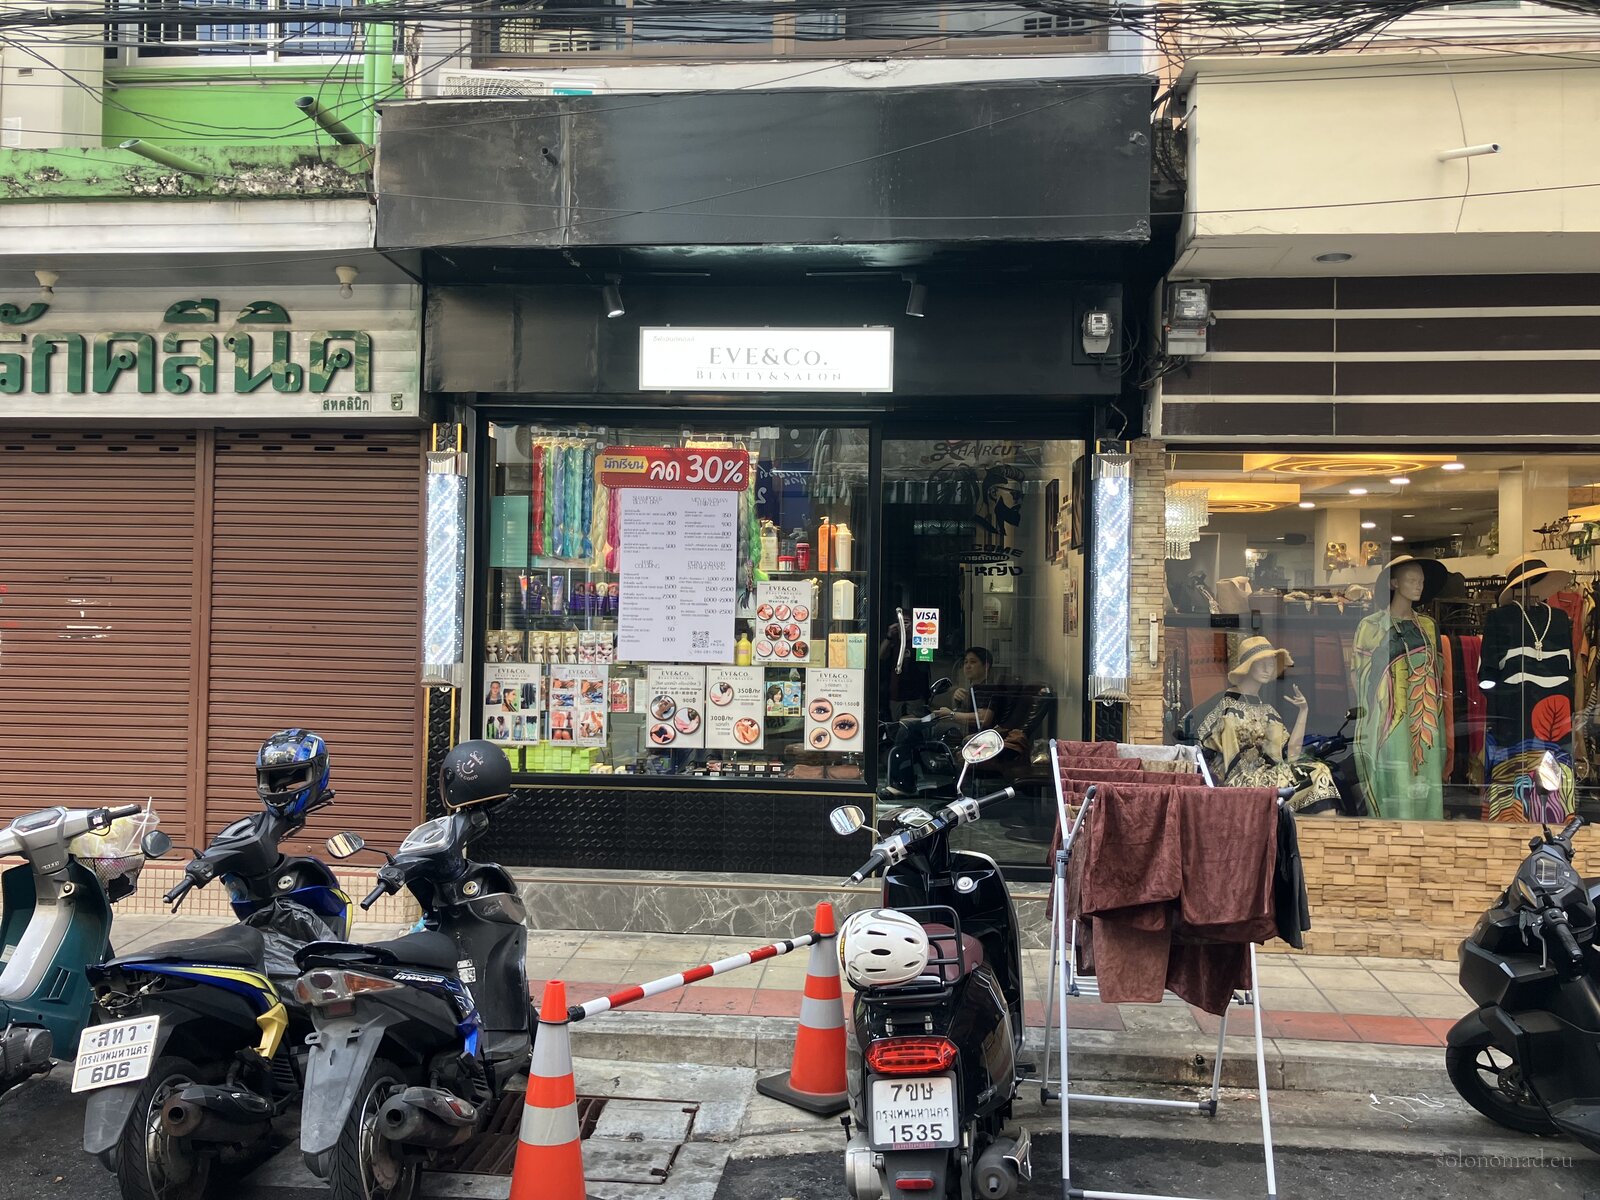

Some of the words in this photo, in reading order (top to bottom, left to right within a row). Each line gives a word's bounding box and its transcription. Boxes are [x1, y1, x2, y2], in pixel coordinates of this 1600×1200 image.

[709, 346, 828, 366] EVE&CO.
[322, 395, 370, 411] สหคลินิก
[603, 457, 644, 470] นักเรียน
[650, 460, 681, 482] ลด
[686, 454, 744, 484] 30%
[915, 612, 937, 620] VISA
[91, 1061, 131, 1084] 606
[875, 1107, 950, 1123] กรุงเทพมหานคร
[889, 1123, 943, 1143] 1535
